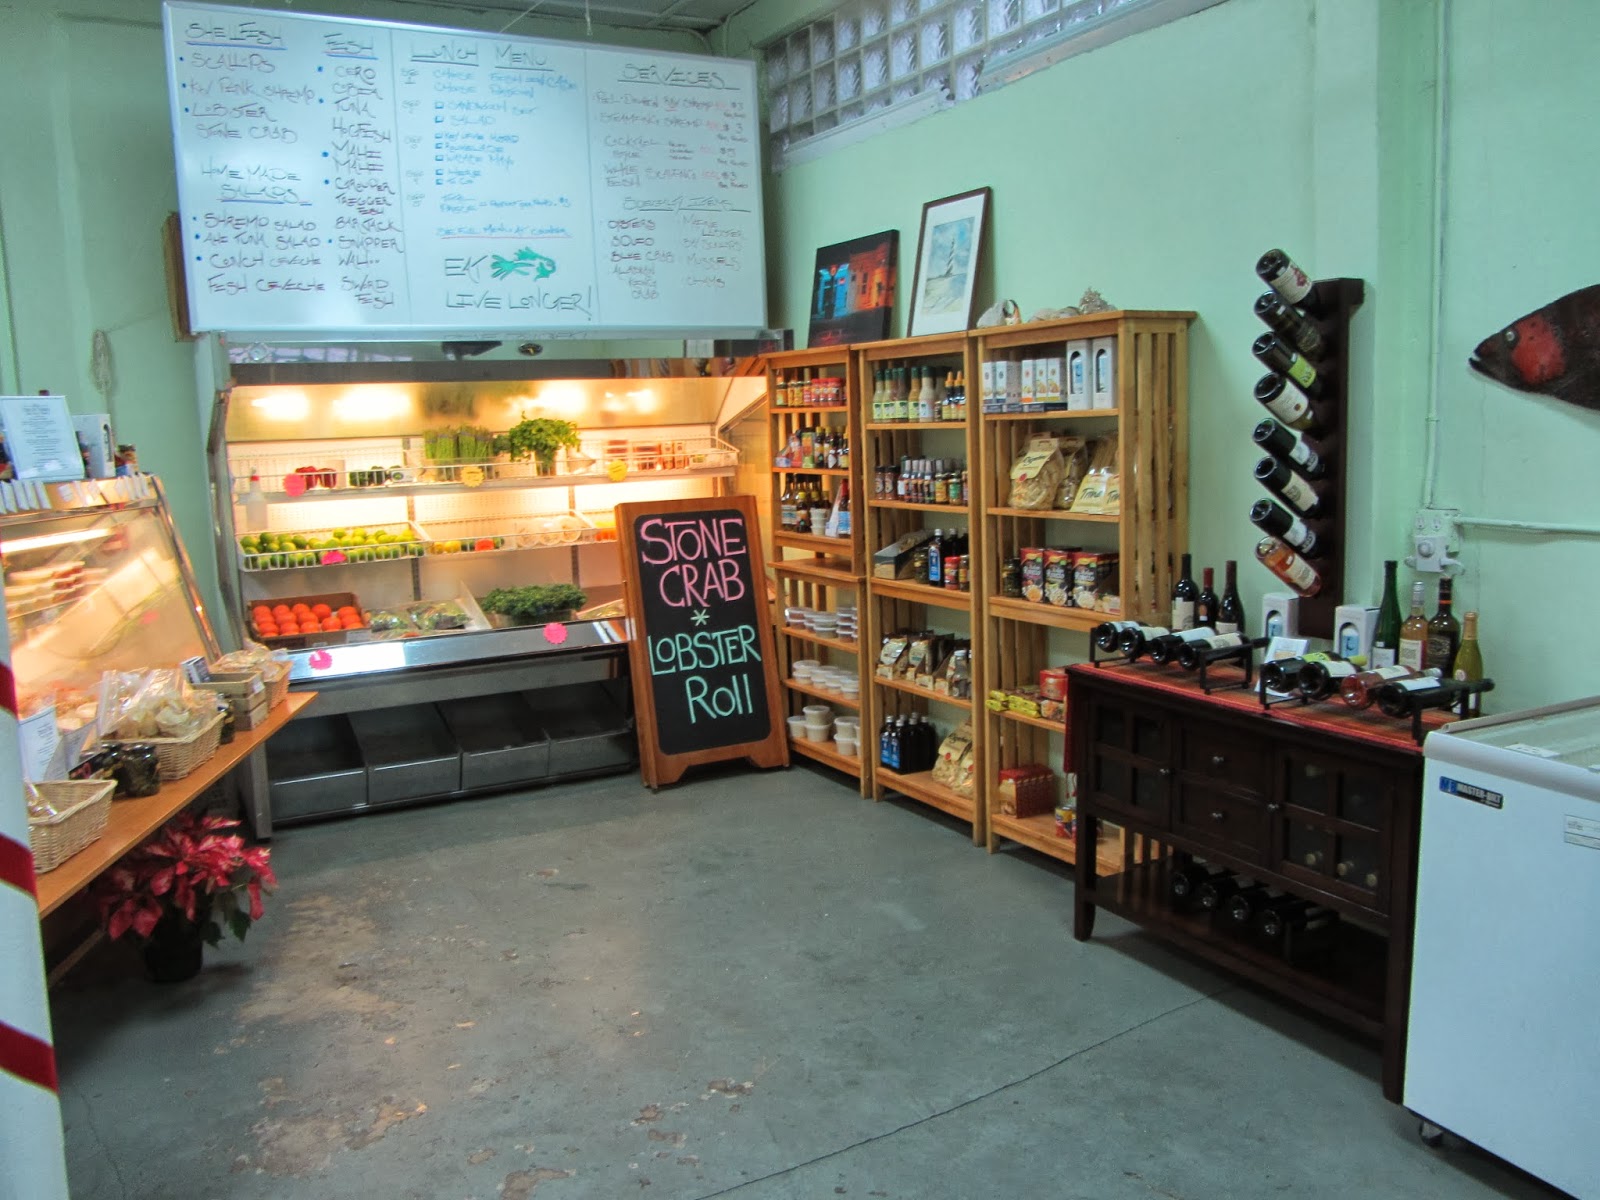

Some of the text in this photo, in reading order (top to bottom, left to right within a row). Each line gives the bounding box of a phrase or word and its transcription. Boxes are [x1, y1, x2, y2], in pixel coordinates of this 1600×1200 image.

[324, 33, 375, 55] FISH
[411, 42, 552, 66] LUNCH MENU
[192, 52, 276, 74] SCALLOPS
[334, 66, 376, 85] CERO
[218, 76, 262, 99] PINK
[263, 84, 316, 106] SHRIMP
[333, 82, 384, 100] COBIA
[192, 102, 278, 123] LOBSTER
[334, 96, 377, 119] TUNA
[196, 122, 298, 144] STONE CRAB
[332, 139, 382, 160] MAHI
[332, 156, 384, 175] MAHI
[221, 184, 299, 204] SALADS
[335, 192, 392, 207] TRIGGER
[204, 210, 316, 234] SHRIMP SALAD
[360, 217, 402, 234] JACK
[234, 231, 269, 248] TUNA
[276, 236, 320, 251] SALAD
[339, 235, 403, 253] SNAPPER
[209, 251, 264, 269] CONCH
[207, 273, 248, 295] FISH
[341, 275, 389, 292] SWORD
[355, 293, 394, 309] FISH
[446, 289, 502, 309] LIVE
[640, 518, 747, 565] STONE
[659, 558, 745, 607] CRAB
[647, 624, 762, 675] LOBSTER
